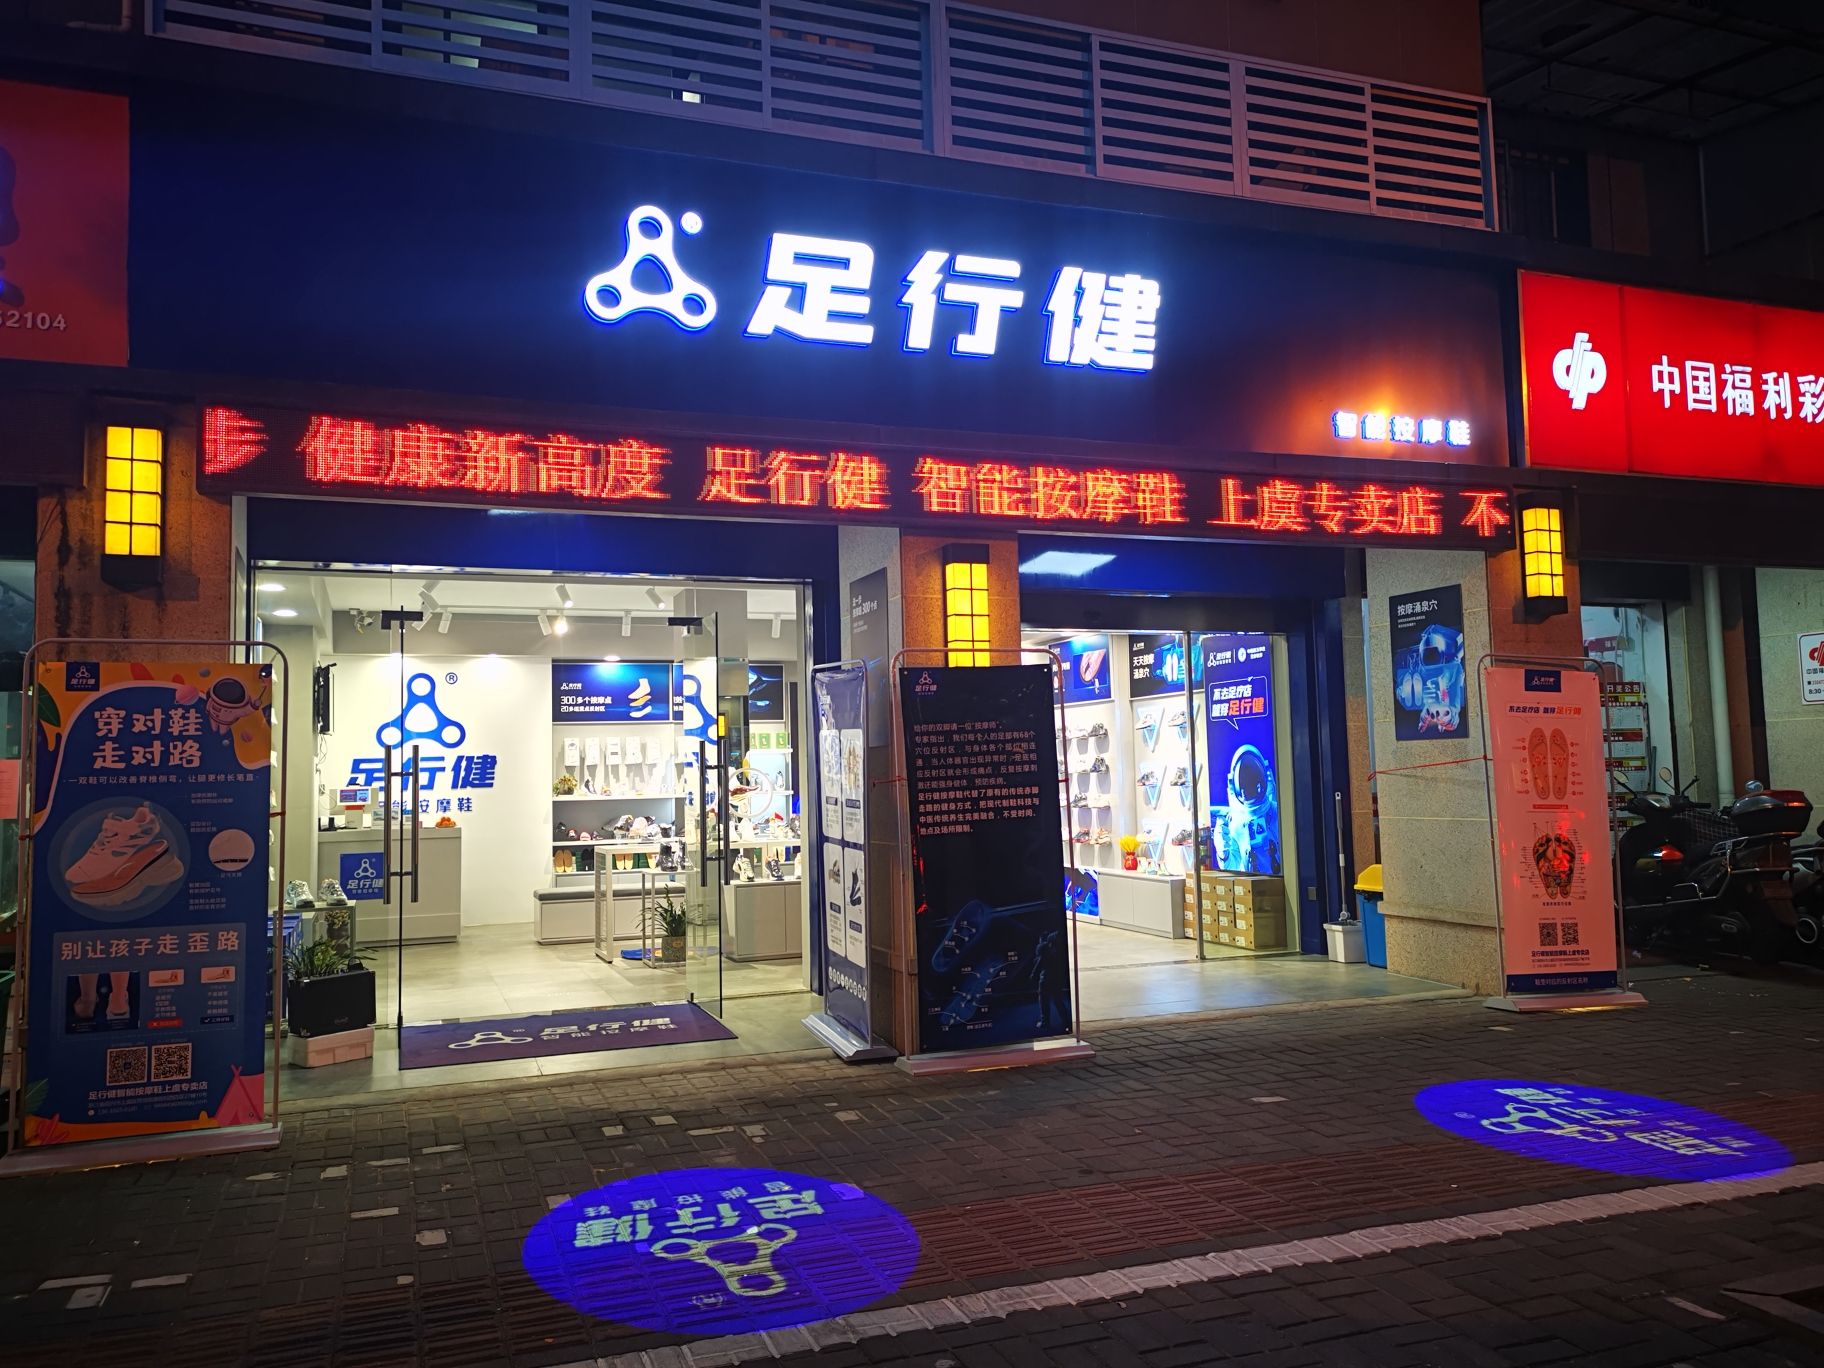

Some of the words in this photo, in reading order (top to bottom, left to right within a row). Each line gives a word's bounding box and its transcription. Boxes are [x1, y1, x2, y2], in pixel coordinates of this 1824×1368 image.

[742, 232, 1161, 373] 足行健
[0, 310, 66, 331] 2104
[1652, 355, 1824, 424] 中国福利彩
[297, 415, 673, 500] 健康新高度
[698, 444, 892, 511] 足行健
[911, 456, 1190, 525] 智能按摩鞋
[1208, 477, 1443, 538] 上虞专卖店
[1397, 599, 1438, 616] 按摩涌泉穴
[94, 707, 203, 736] 穿对鞋
[93, 740, 202, 769] 走对路
[60, 930, 240, 961] 别让孩子走歪路
[573, 1189, 825, 1248] 足行健
